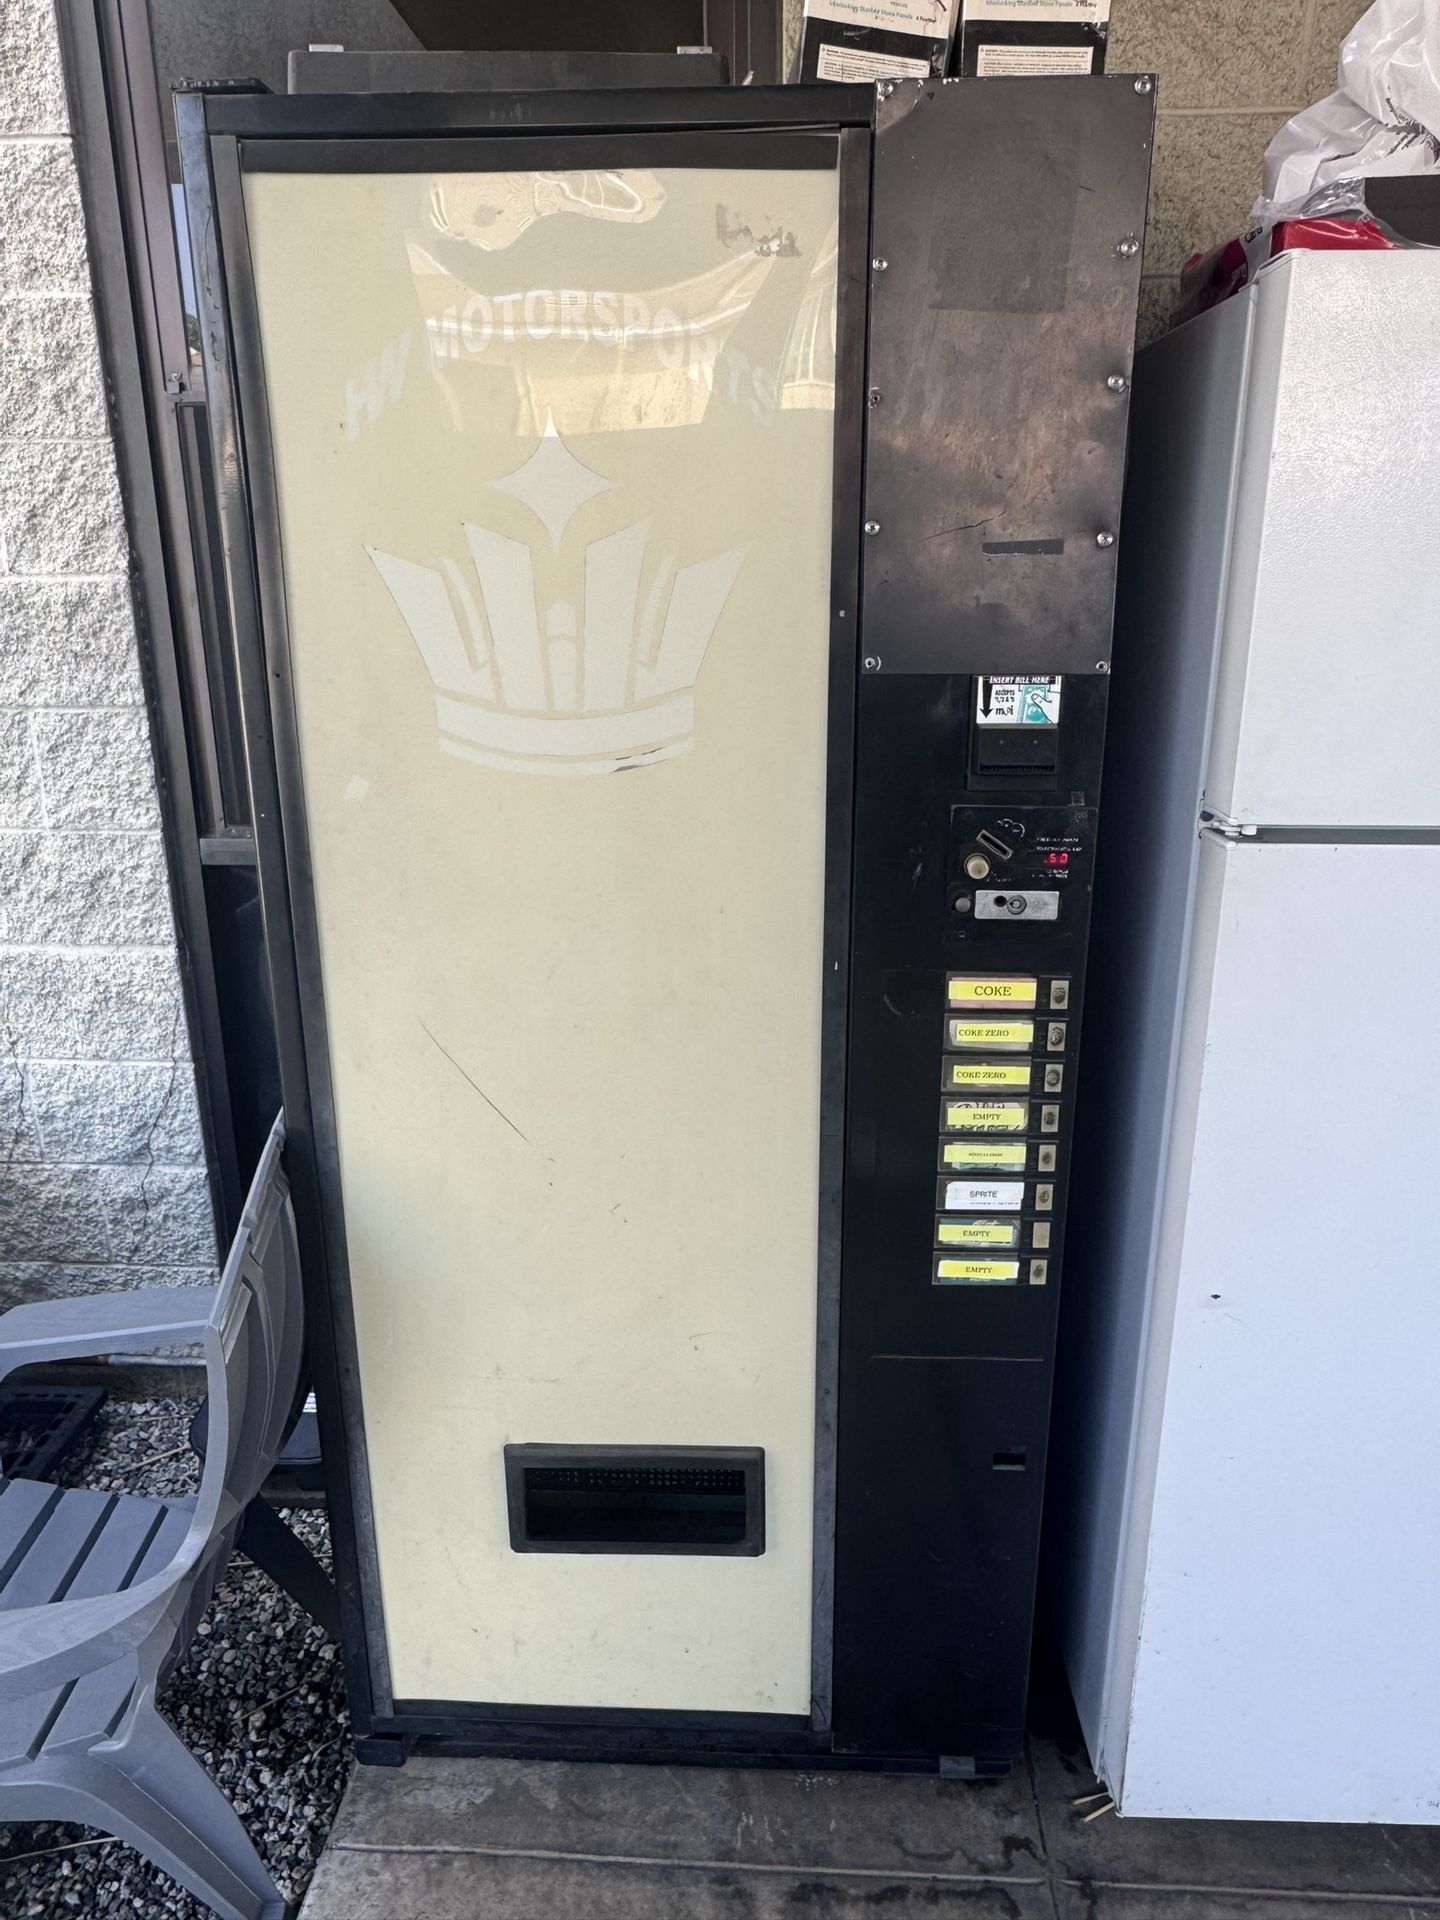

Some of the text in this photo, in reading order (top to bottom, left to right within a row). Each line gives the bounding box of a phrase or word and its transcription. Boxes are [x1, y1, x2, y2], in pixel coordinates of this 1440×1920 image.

[424, 289, 777, 428] MOTORSPORTS
[989, 676, 1050, 684] INSERT BILL HERE
[974, 985, 1012, 997] COKE
[958, 1029, 1010, 1037] COKE ZERO
[956, 1071, 1007, 1079] COKE ZERO
[972, 1113, 1002, 1121] EMPTY
[969, 1190, 998, 1198] SPRITE
[963, 1229, 991, 1237] EMPTY
[965, 1266, 993, 1274] EMPTY
